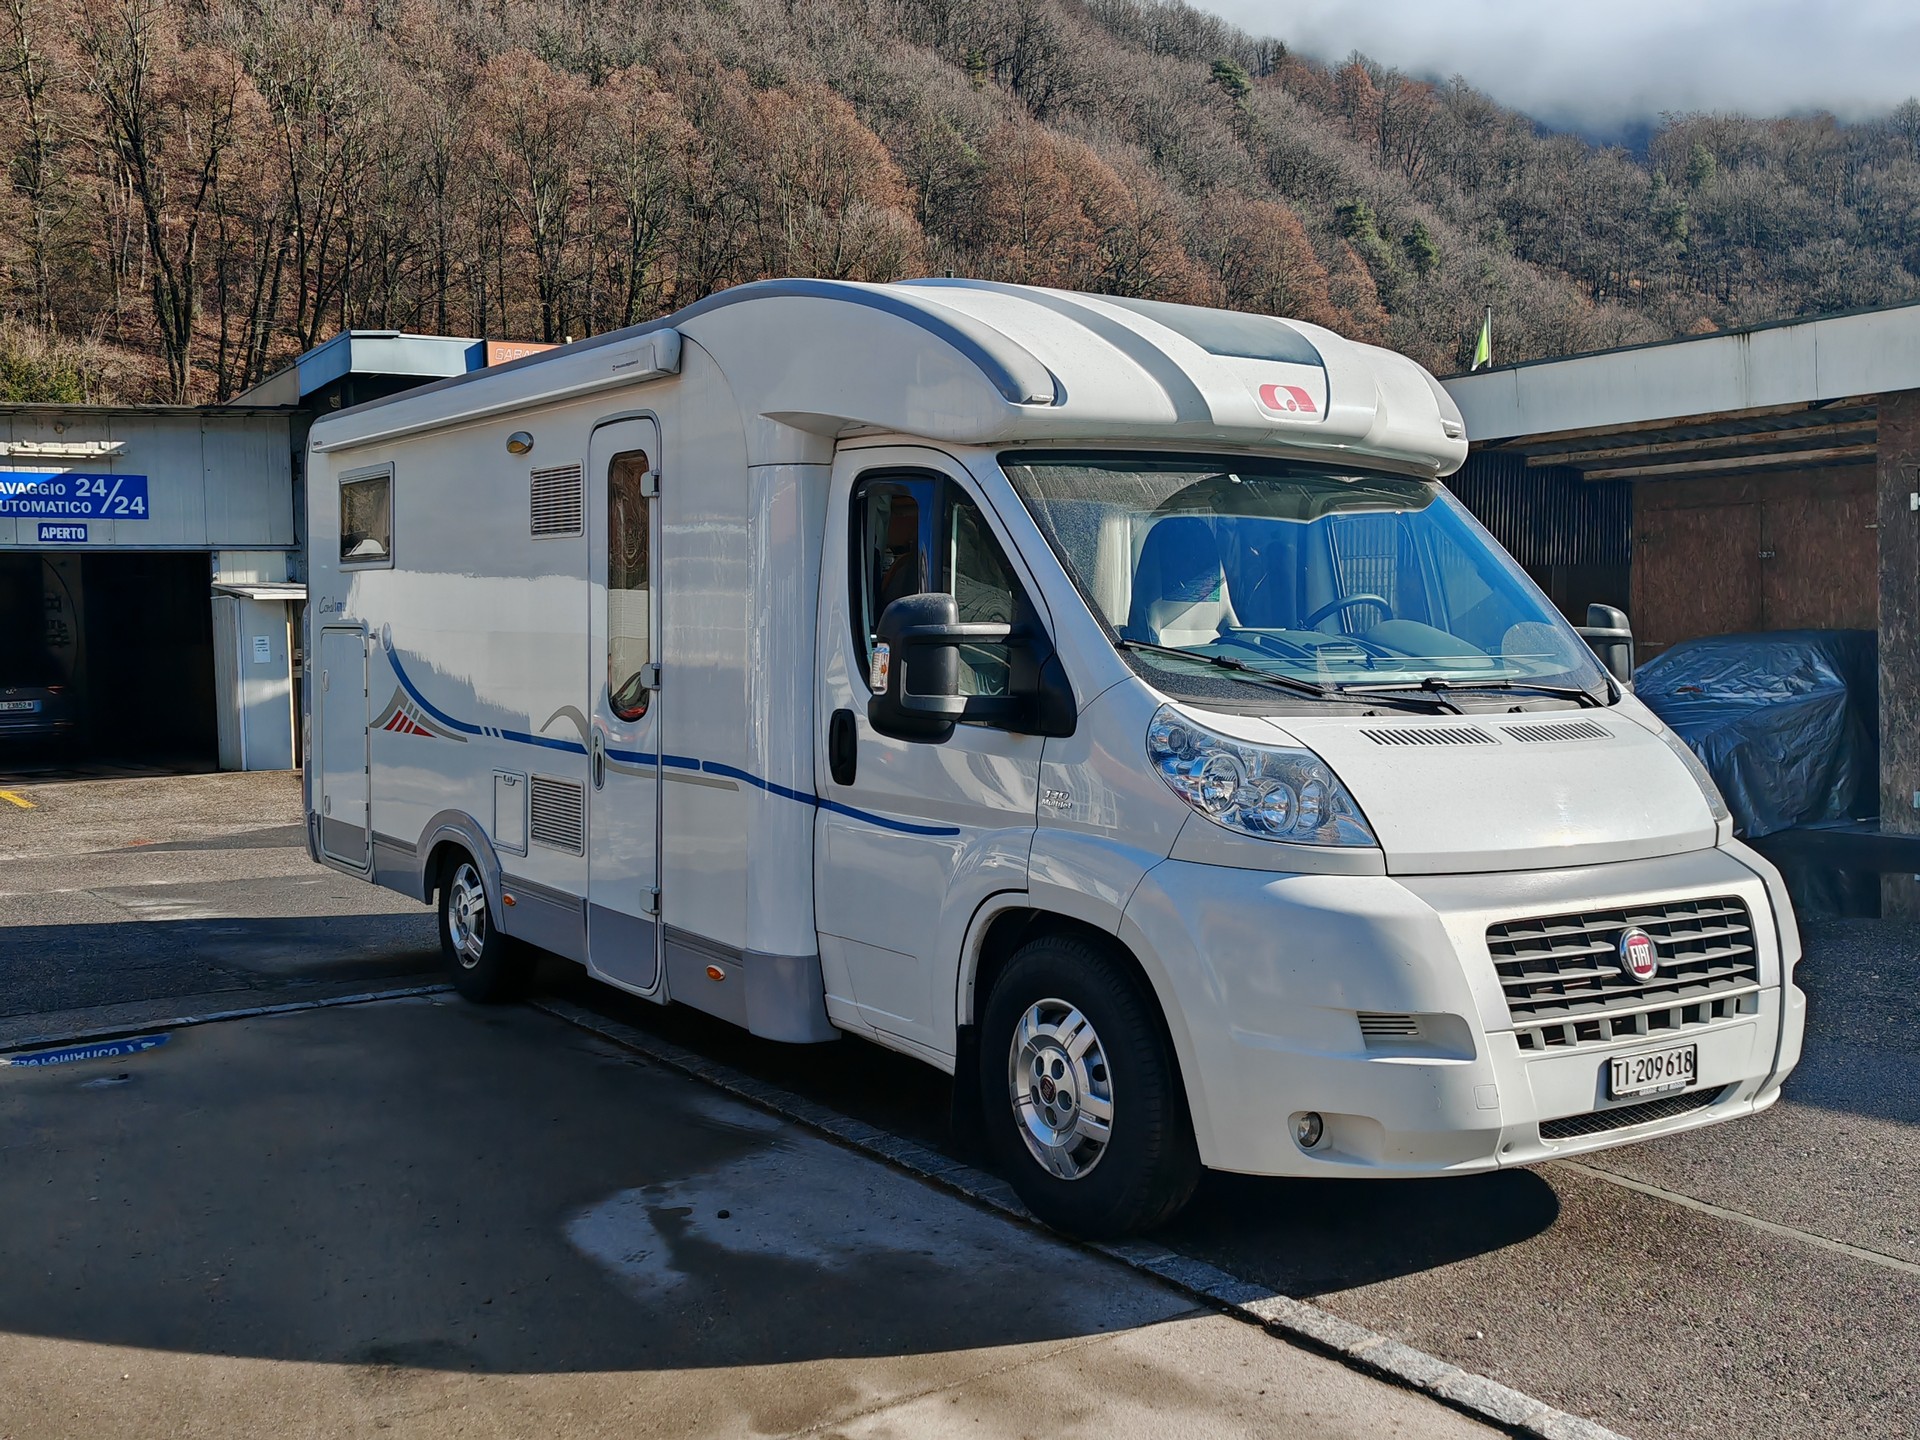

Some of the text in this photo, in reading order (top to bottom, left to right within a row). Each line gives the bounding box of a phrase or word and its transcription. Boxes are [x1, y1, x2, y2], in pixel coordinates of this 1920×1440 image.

[495, 348, 541, 361] GARA
[0, 499, 92, 513] UTOMATICO
[41, 526, 86, 539] APERTO
[1629, 943, 1651, 968] FIAT
